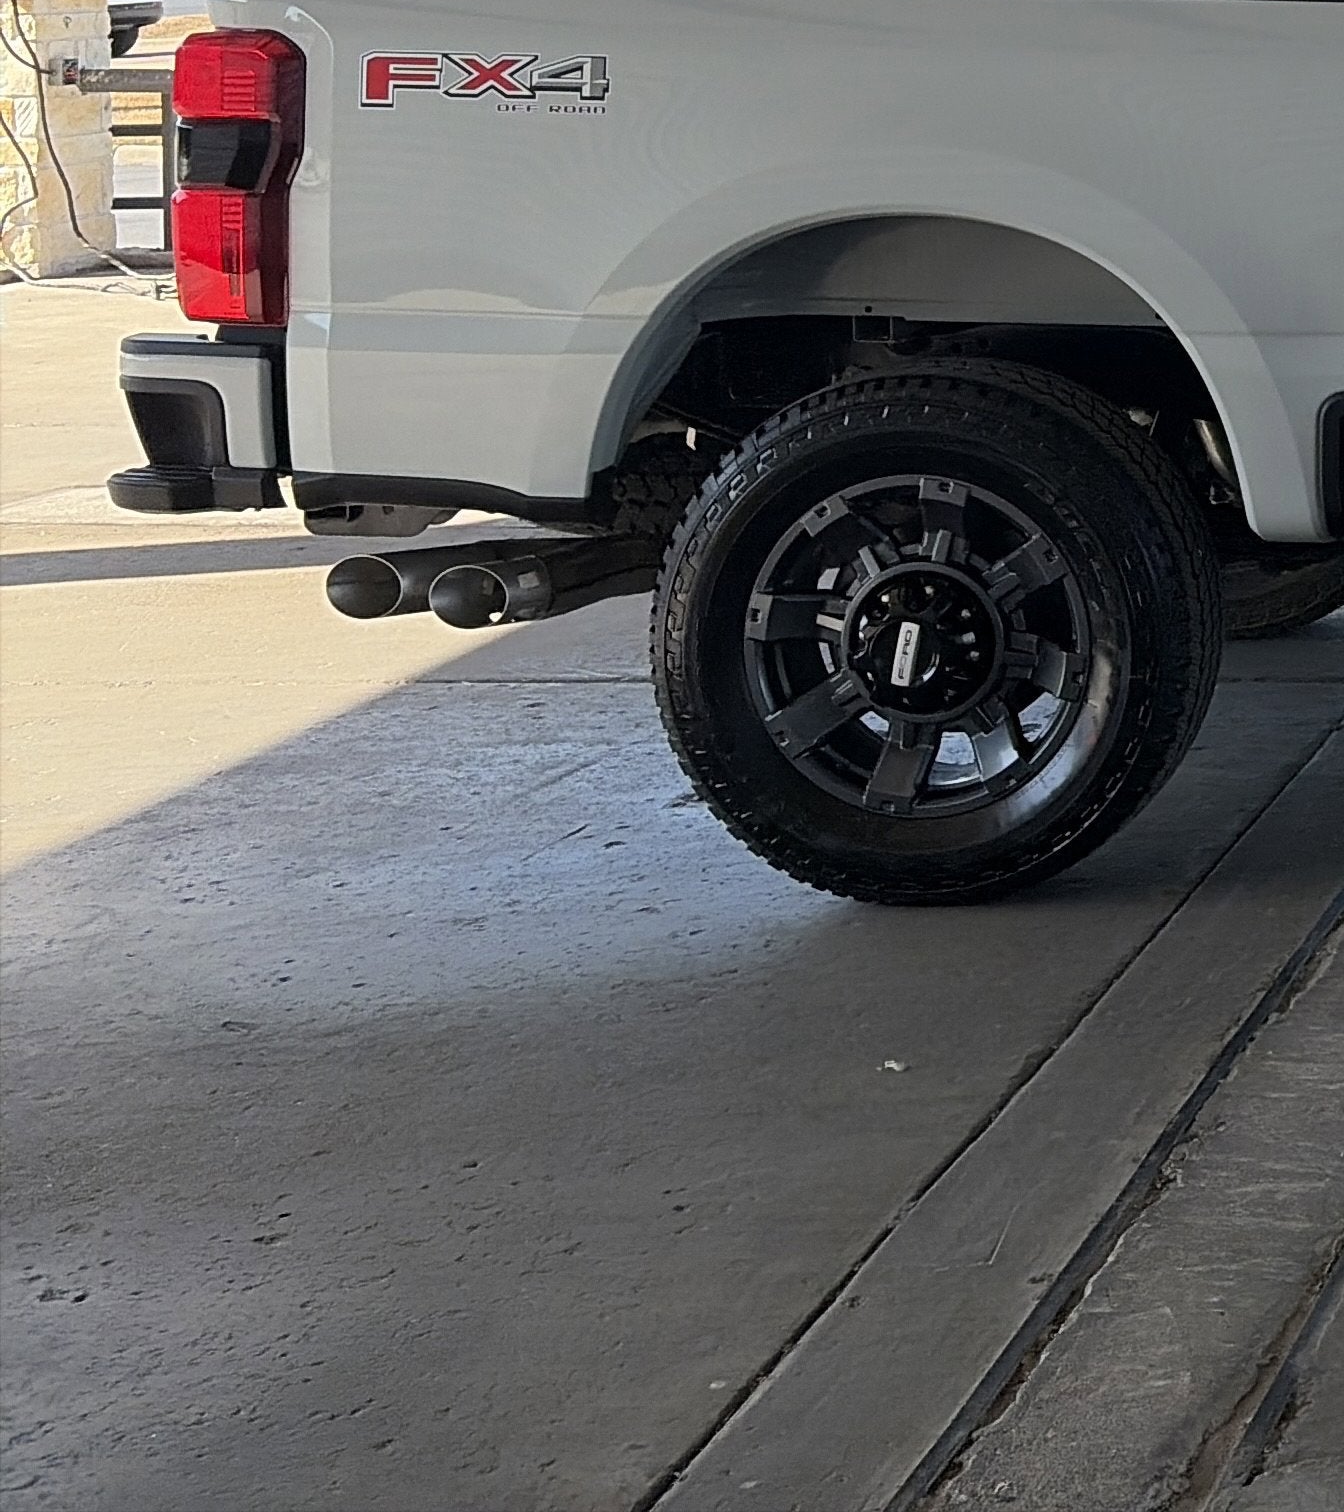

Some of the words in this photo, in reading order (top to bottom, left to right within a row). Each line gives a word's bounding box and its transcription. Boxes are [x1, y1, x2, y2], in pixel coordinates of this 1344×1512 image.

[359, 50, 611, 109] FX4
[496, 103, 538, 114] OFF
[549, 104, 607, 115] ROAD
[897, 629, 912, 680] FORD
